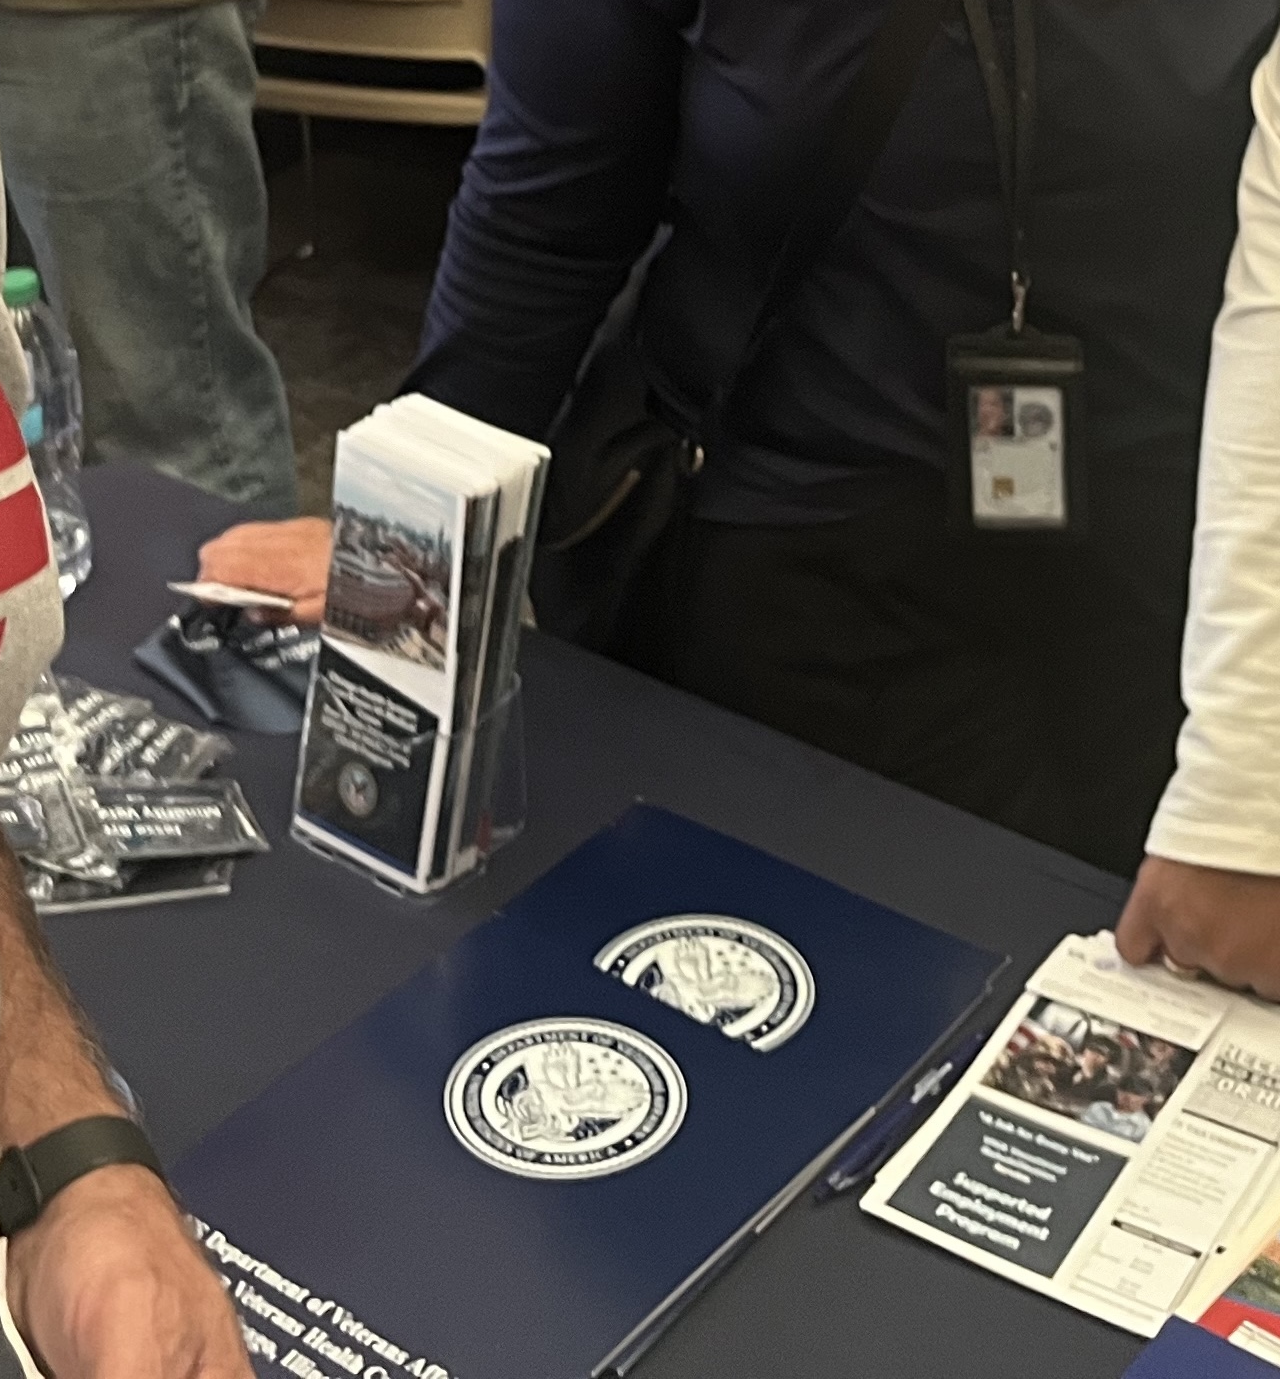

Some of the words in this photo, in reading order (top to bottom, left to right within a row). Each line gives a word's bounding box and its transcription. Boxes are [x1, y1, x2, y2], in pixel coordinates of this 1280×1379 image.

[205, 1229, 311, 1303] Department
[305, 1296, 337, 1318] of
[331, 1305, 411, 1366] Veterans
[234, 1279, 307, 1338] Veterans
[302, 1326, 366, 1376] Health
